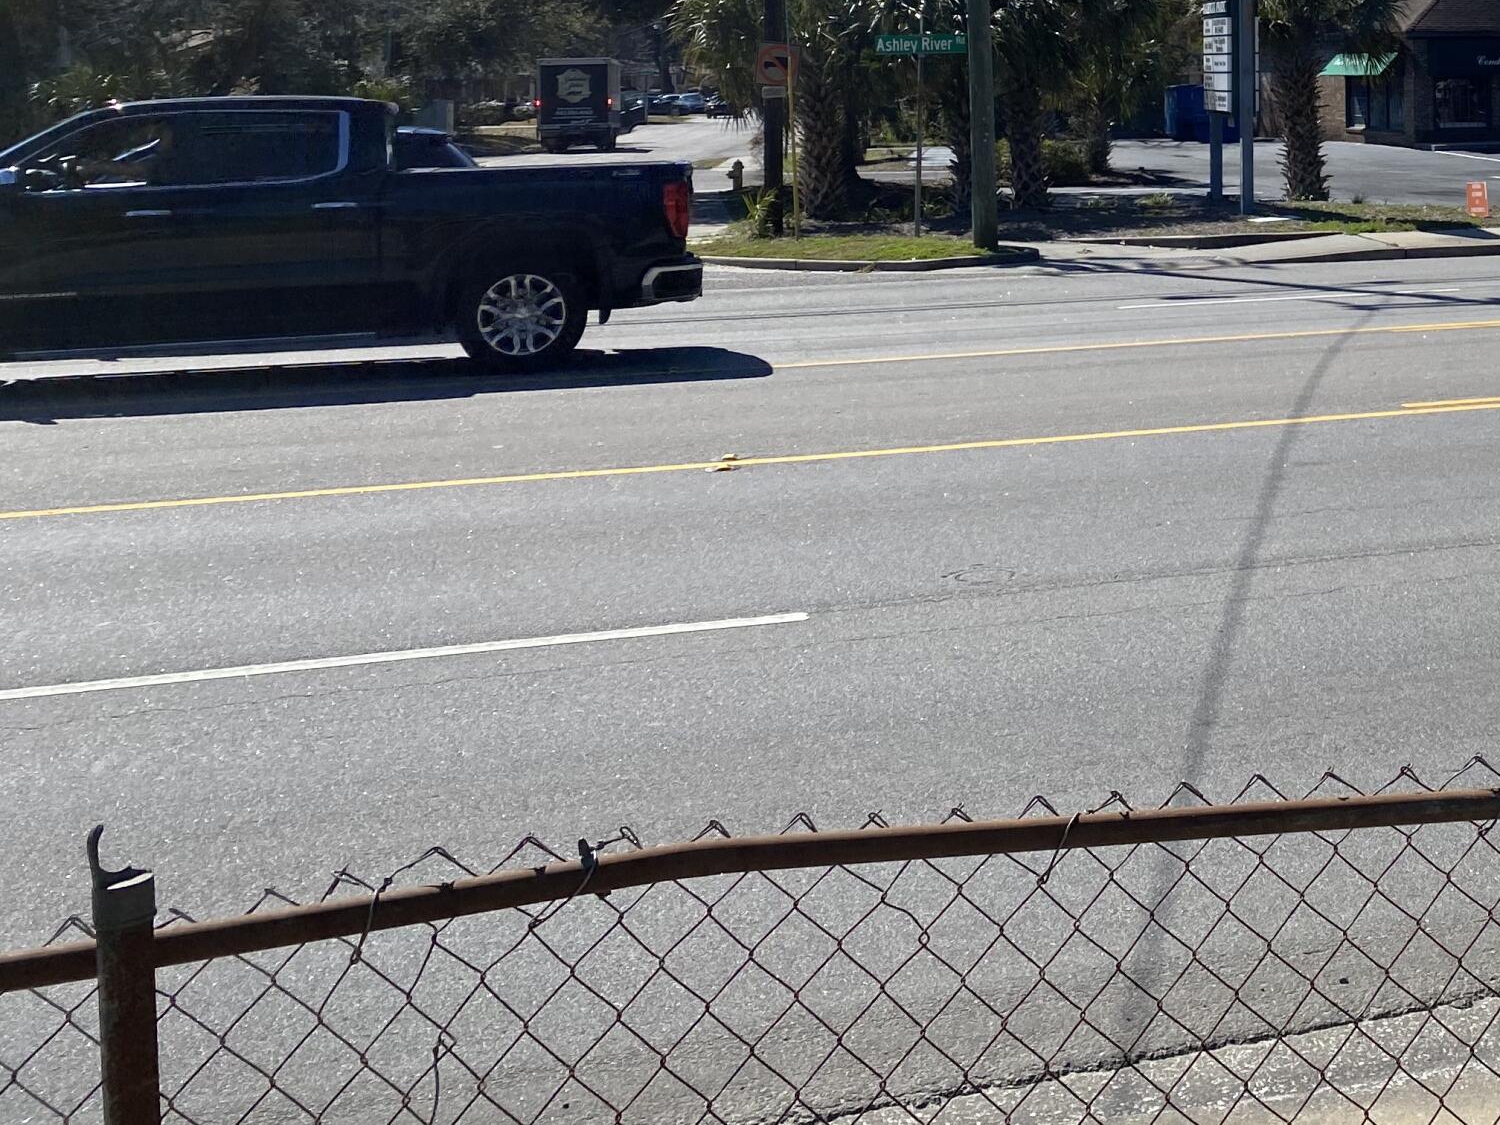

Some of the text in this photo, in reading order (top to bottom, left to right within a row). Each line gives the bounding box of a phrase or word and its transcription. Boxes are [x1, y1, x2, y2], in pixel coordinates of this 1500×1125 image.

[876, 36, 966, 53] Ashley River Rd
